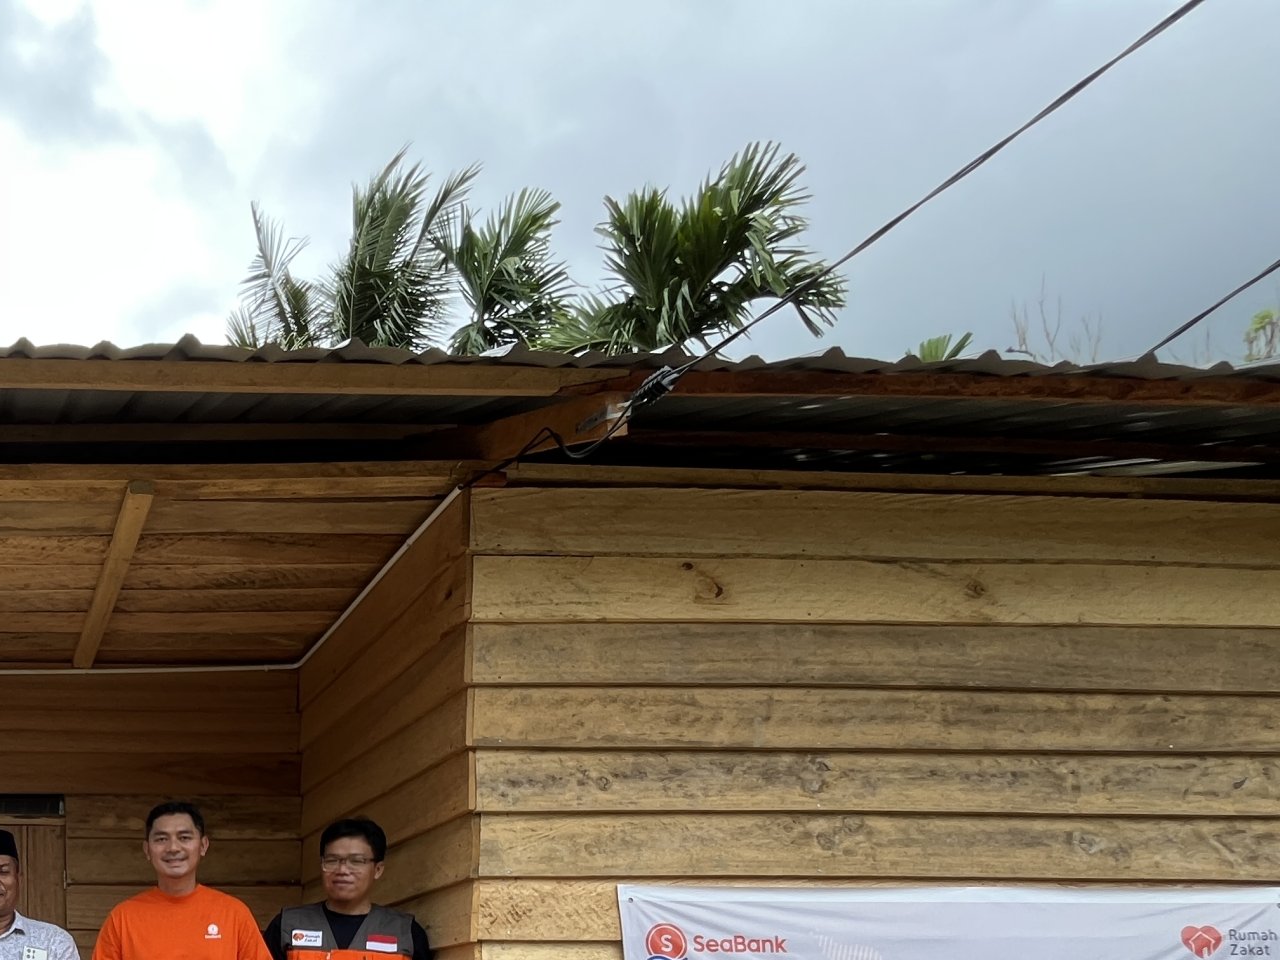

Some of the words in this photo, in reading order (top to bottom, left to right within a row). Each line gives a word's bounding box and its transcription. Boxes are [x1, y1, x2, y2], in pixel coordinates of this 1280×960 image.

[1228, 929, 1278, 941] Rumah
[693, 935, 787, 953] SeaBank
[1230, 943, 1270, 956] Zakat
